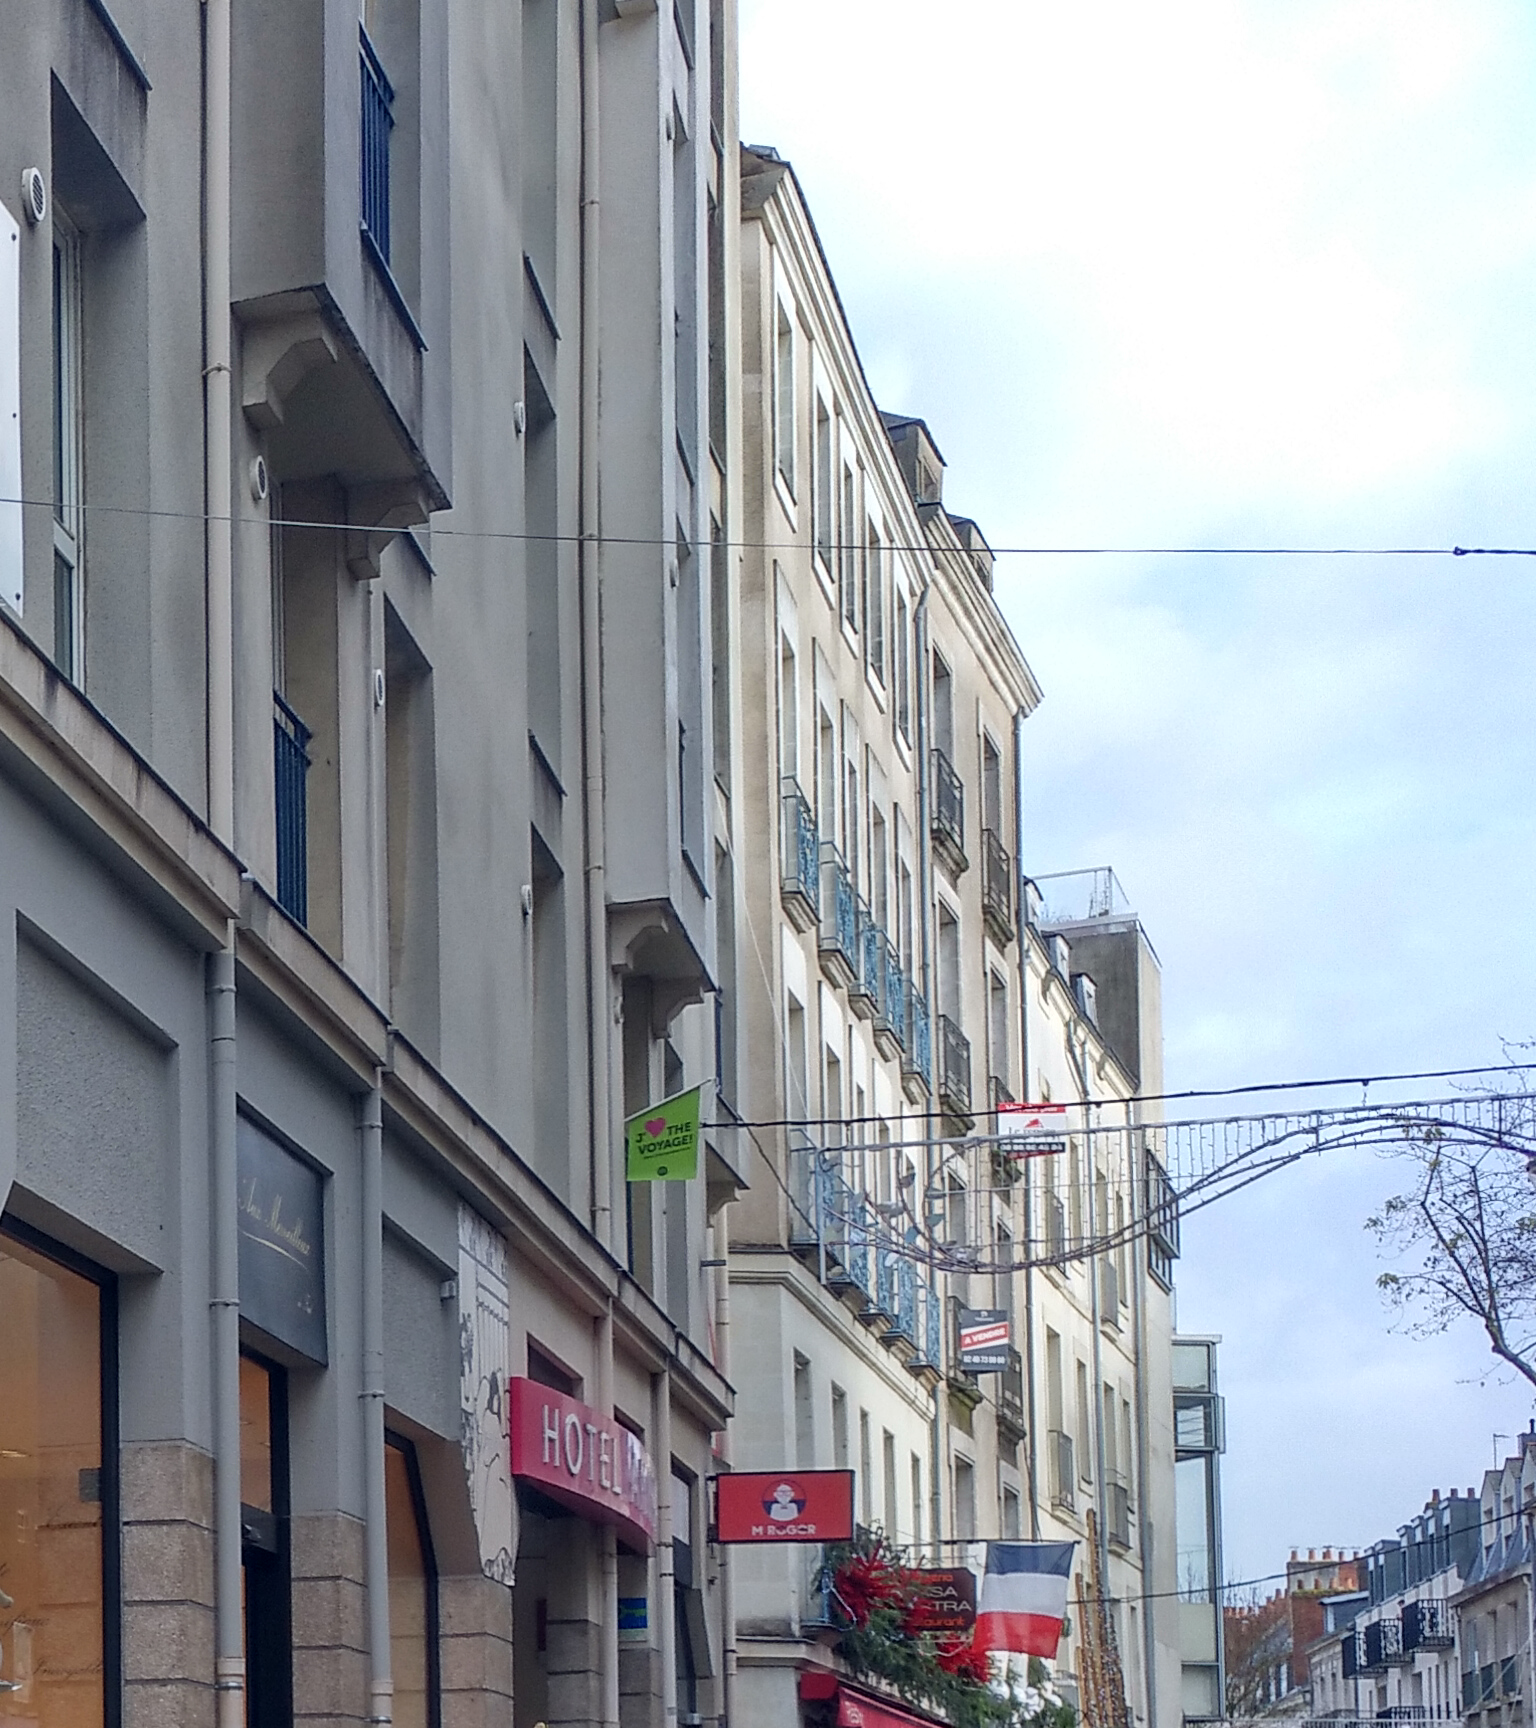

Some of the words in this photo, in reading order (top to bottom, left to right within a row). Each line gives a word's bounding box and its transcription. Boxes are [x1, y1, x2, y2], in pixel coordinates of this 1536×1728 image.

[666, 1121, 691, 1136] THE
[637, 1133, 693, 1155] VOYAGE!
[543, 1403, 623, 1496] HOTEL
[752, 1525, 763, 1536] M
